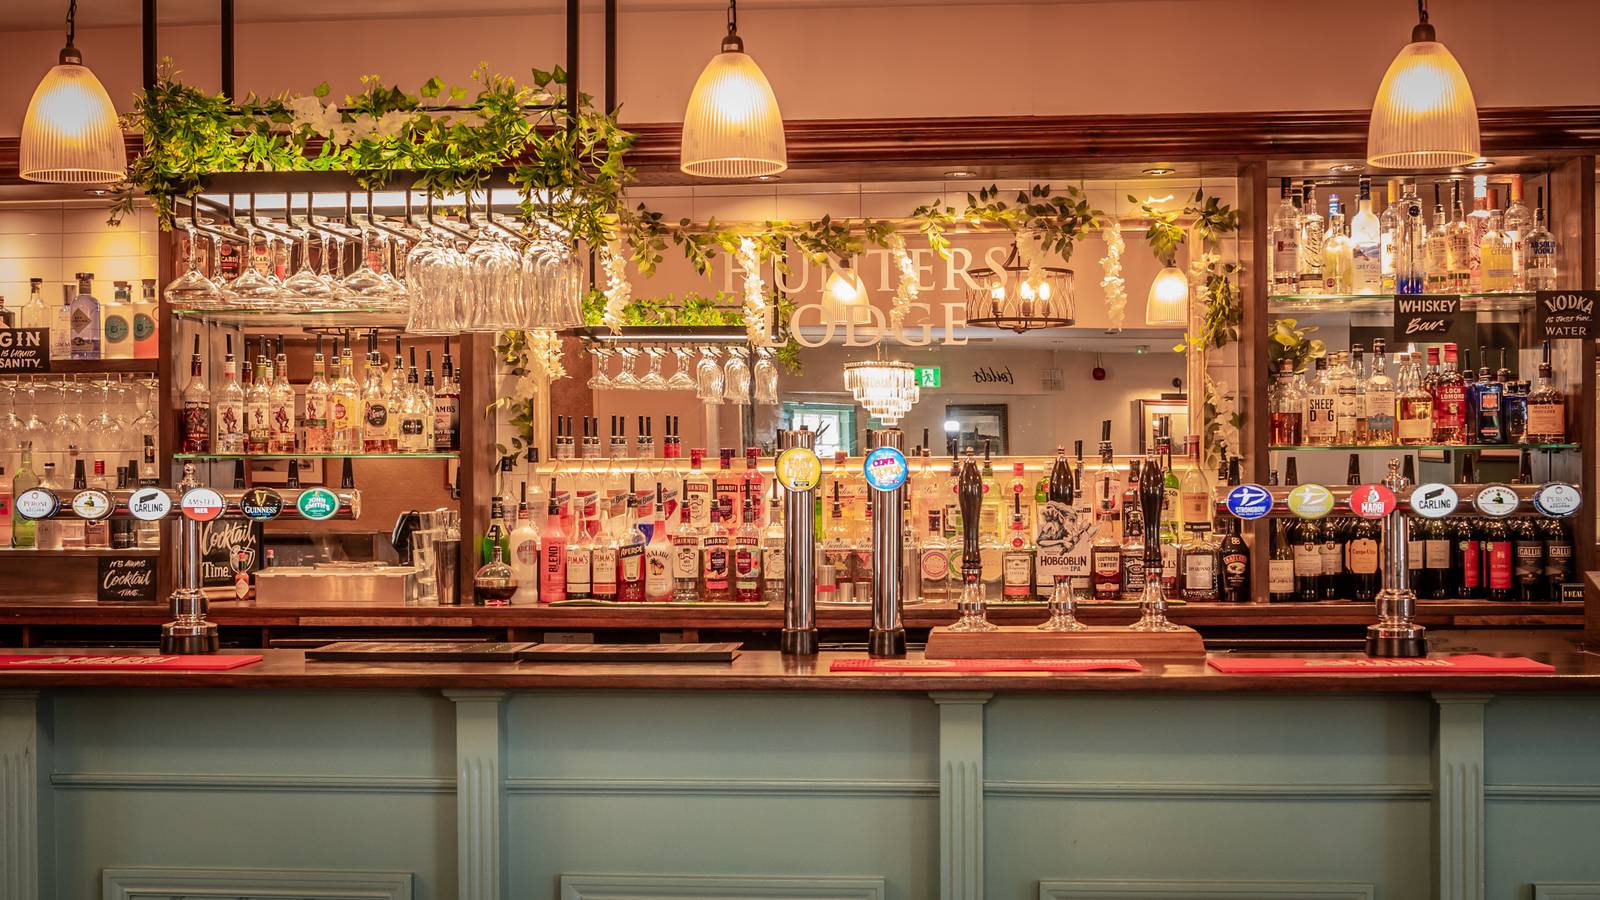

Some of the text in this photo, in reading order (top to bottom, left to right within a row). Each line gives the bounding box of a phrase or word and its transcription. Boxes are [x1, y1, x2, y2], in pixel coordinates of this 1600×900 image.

[1399, 300, 1457, 313] WHISKEY
[1544, 294, 1595, 314] VODKA
[762, 301, 969, 348] LODGE
[1545, 326, 1587, 336] WATER
[0, 331, 41, 347] GIN
[1309, 398, 1334, 409] SHEEP
[134, 503, 163, 512] CARLING
[244, 505, 278, 514] GUINNESS
[1418, 500, 1452, 510] CARLING
[202, 521, 256, 556] Cocktail
[547, 545, 559, 573] BLEND
[568, 553, 588, 564] PIMM'S
[594, 551, 615, 562] PIMM'S
[1040, 555, 1087, 567] HOBGOBLIN
[109, 560, 123, 568] IT'S
[103, 569, 152, 590] Cocktail
